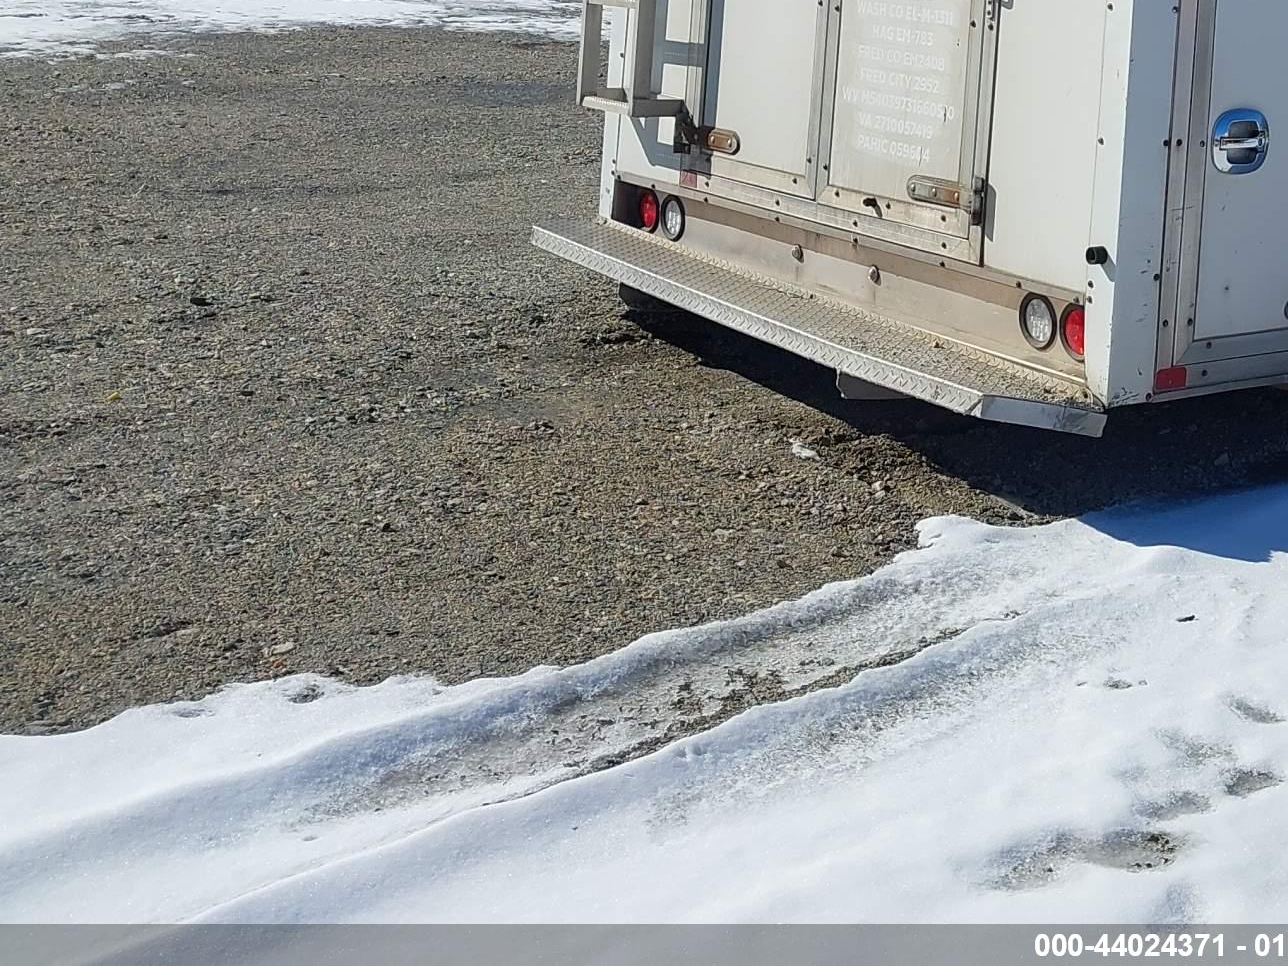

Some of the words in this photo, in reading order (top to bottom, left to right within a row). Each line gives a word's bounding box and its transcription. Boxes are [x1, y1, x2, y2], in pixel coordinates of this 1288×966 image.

[857, 0, 887, 17] WASH
[889, 3, 904, 18] CO
[872, 25, 895, 41] HAG
[858, 44, 884, 60] FRED
[887, 49, 901, 63] CO
[860, 66, 886, 83] FRED
[888, 72, 912, 89] CITY
[842, 84, 858, 102] WV
[858, 112, 872, 127] VA
